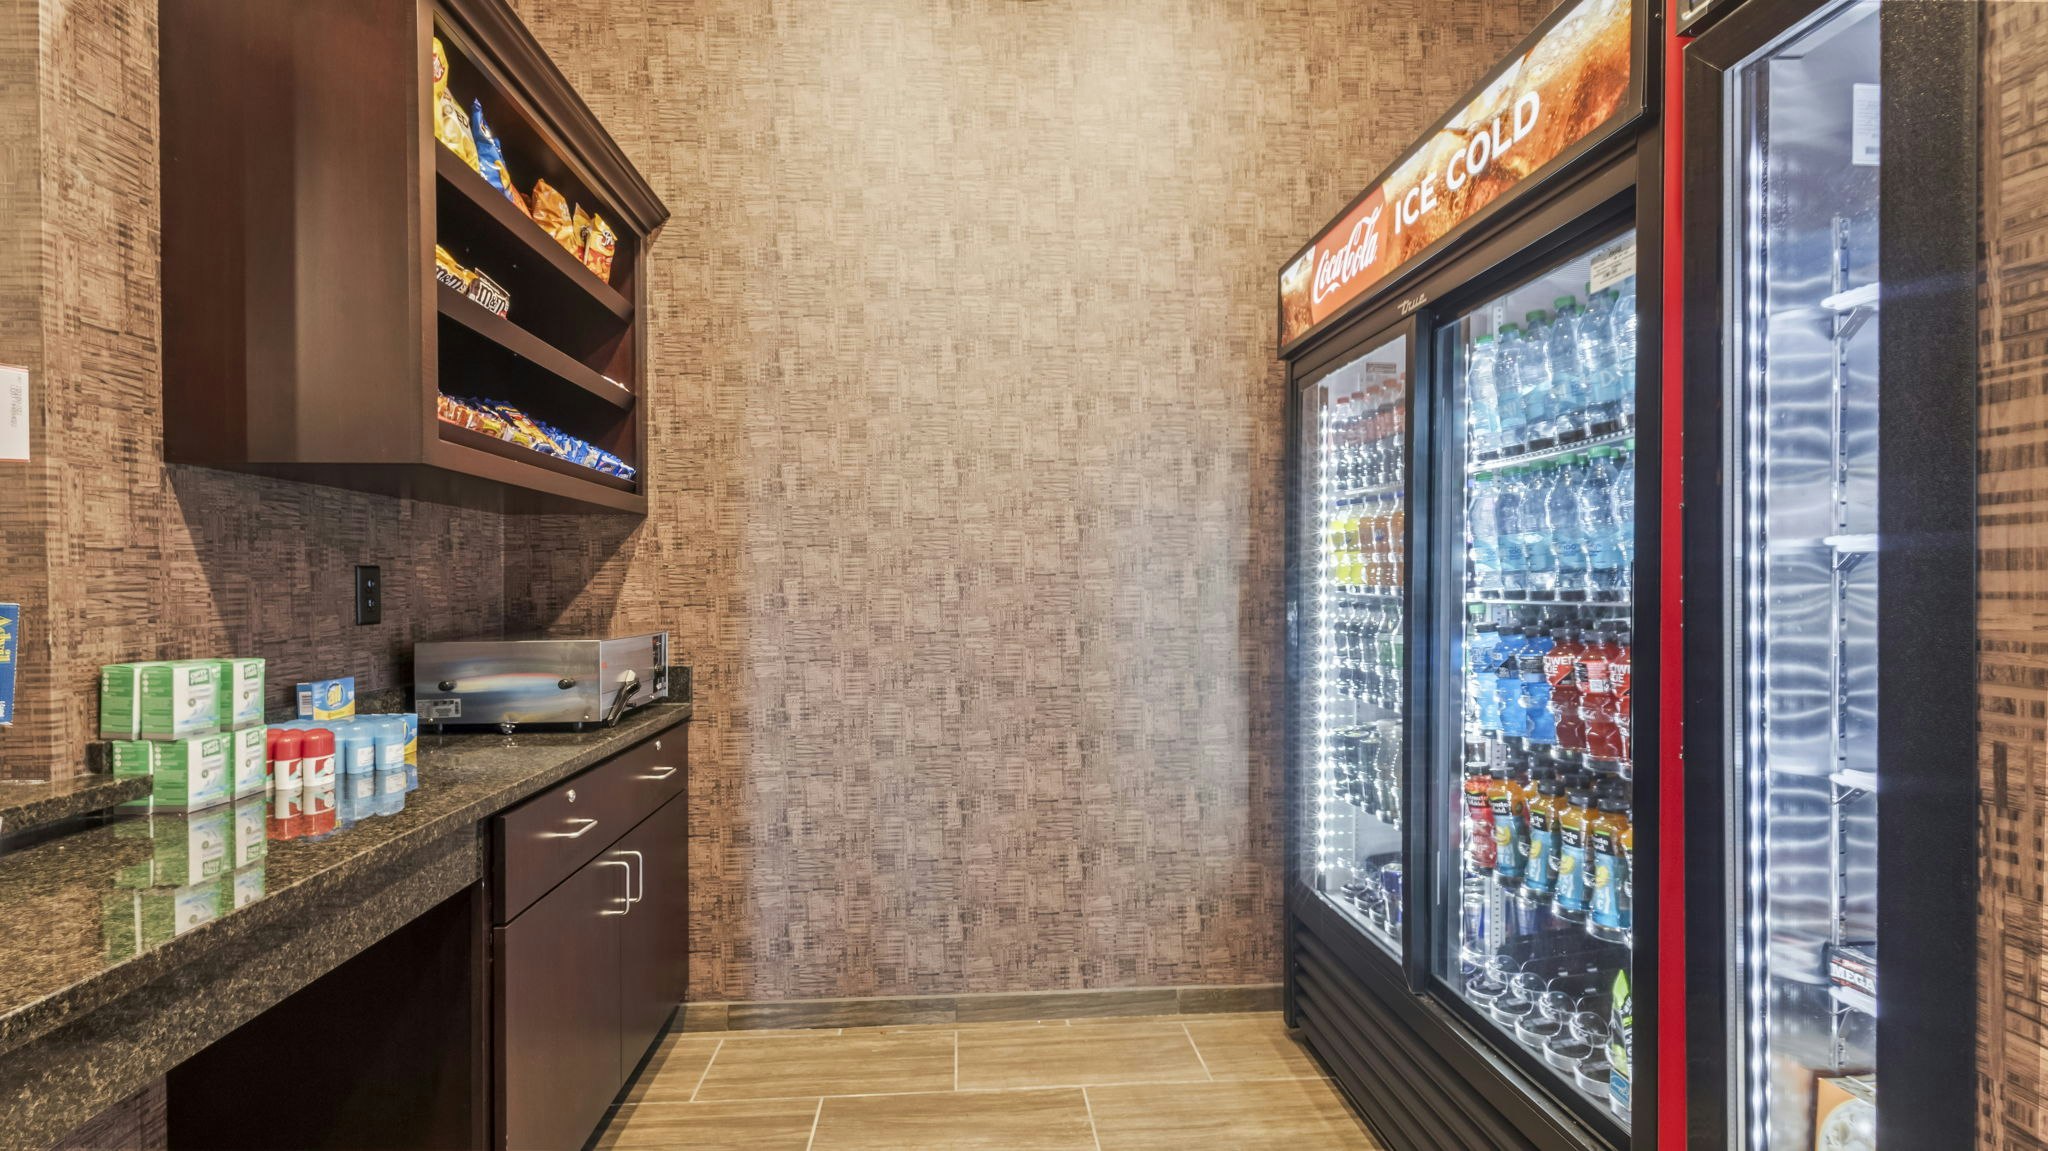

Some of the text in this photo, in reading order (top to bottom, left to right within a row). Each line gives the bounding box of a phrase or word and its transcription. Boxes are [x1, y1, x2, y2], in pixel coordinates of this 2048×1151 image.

[1395, 91, 1540, 235] ICE COLD
[1830, 963, 1876, 994] MEGA
